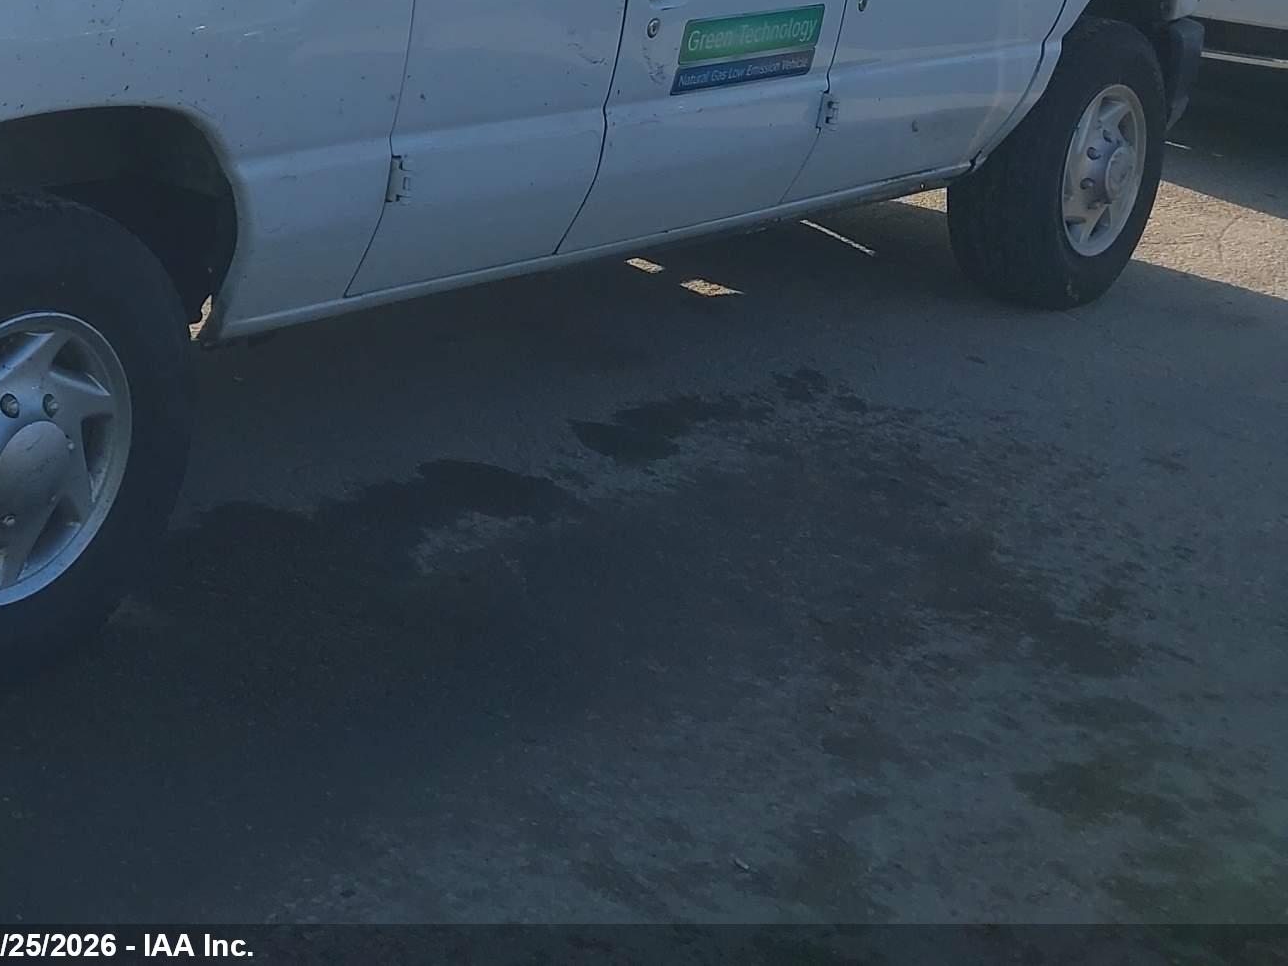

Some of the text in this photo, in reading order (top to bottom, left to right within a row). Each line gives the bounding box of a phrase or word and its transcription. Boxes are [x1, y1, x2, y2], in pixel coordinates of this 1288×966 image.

[688, 17, 817, 51] Green Technology
[679, 72, 709, 86] Natural
[711, 68, 728, 81] Gas
[728, 66, 746, 79] Low
